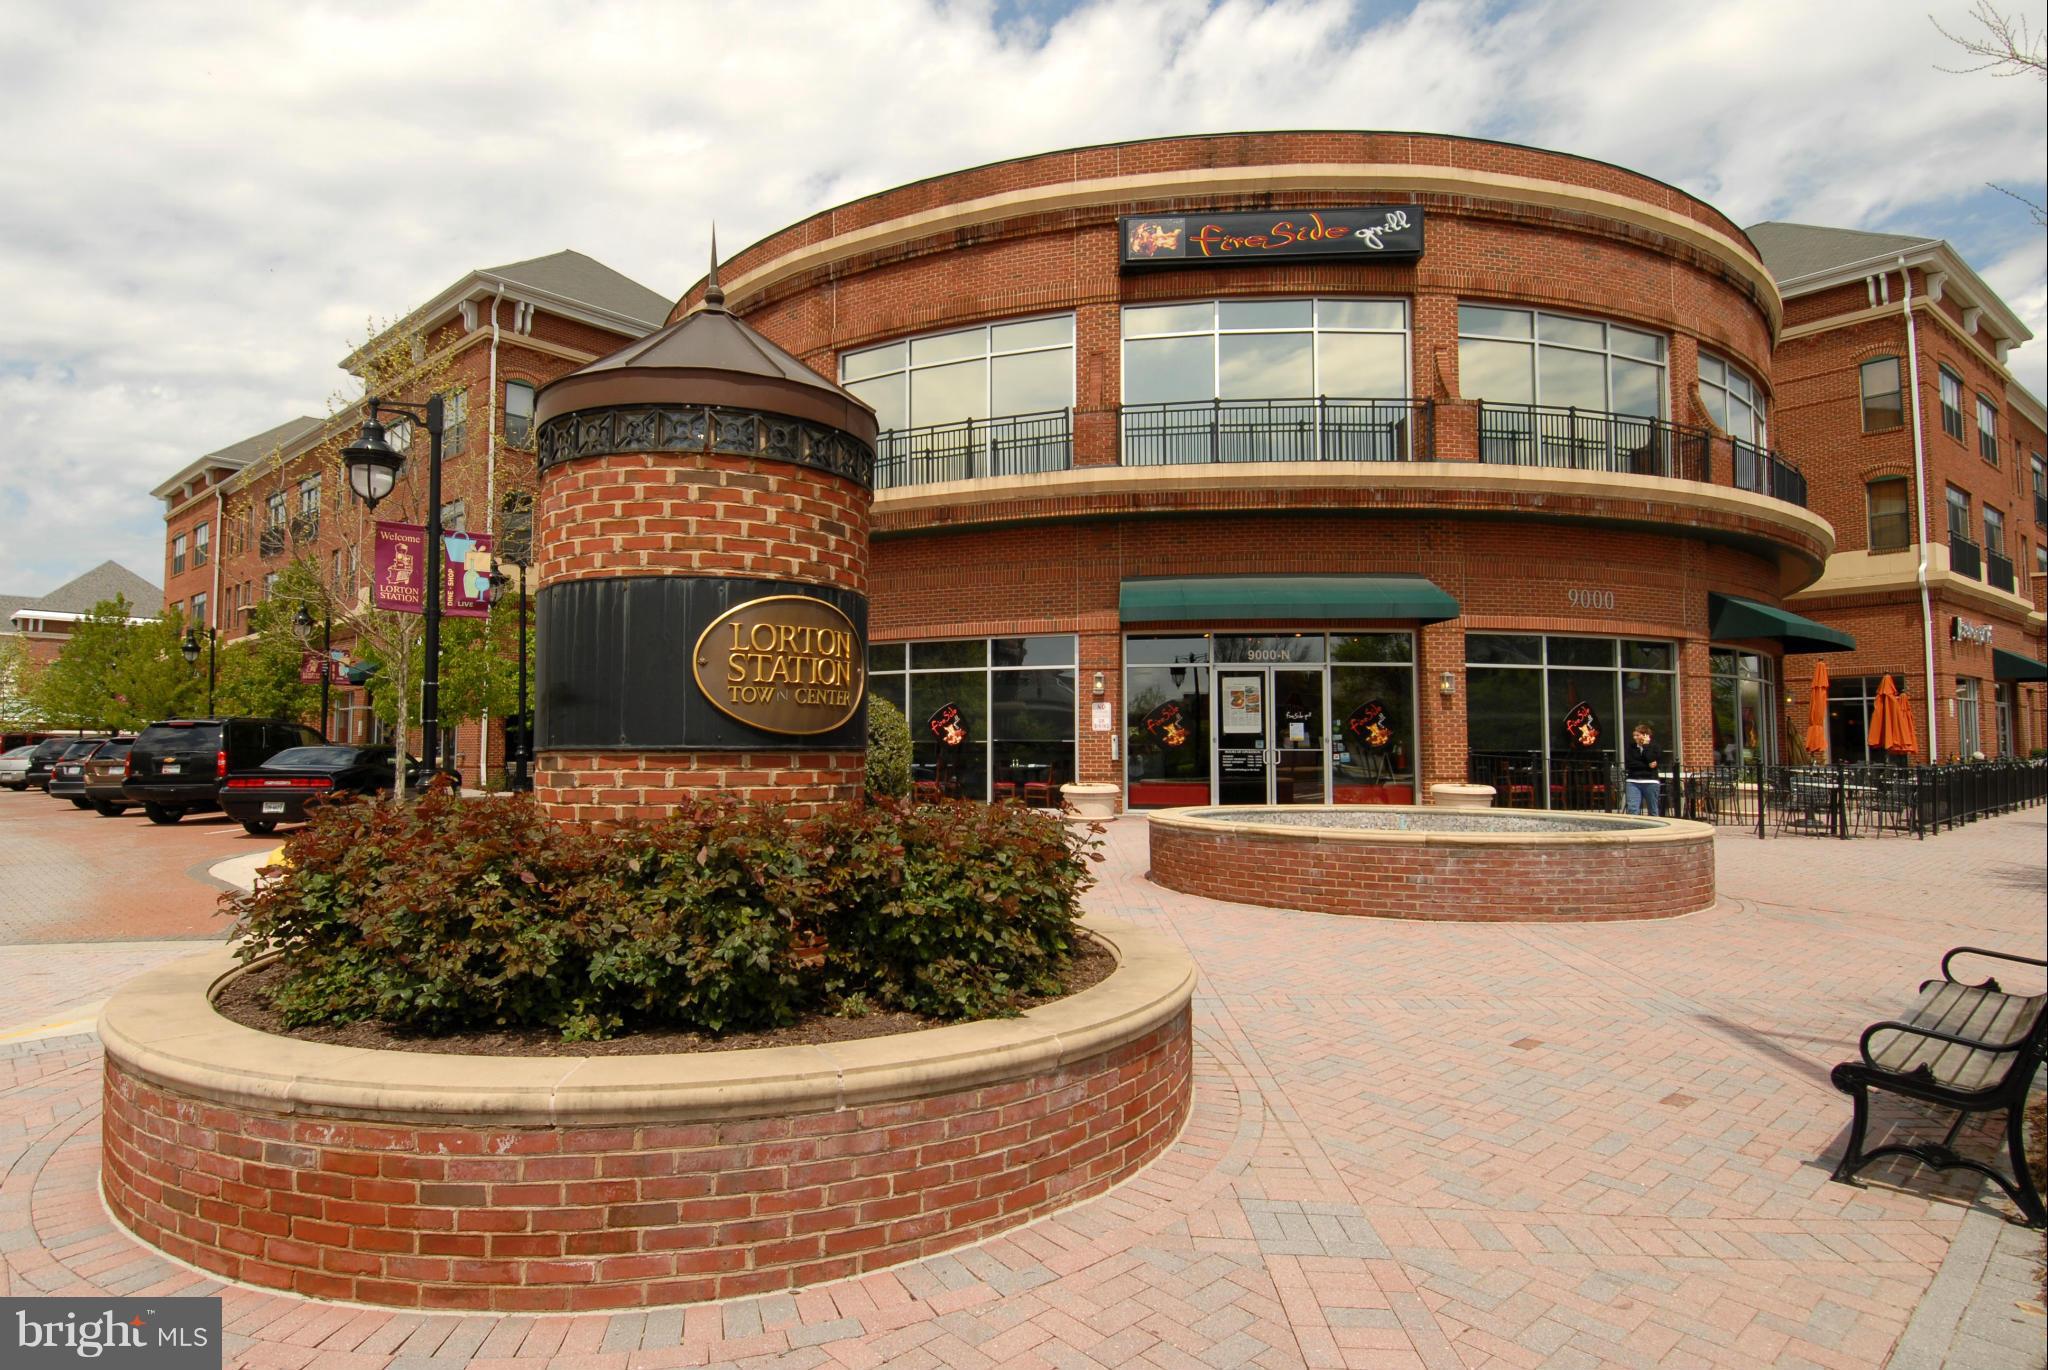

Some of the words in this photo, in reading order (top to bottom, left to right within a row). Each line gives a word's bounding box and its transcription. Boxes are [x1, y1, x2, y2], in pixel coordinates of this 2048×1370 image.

[1354, 210, 1411, 250] grill
[380, 531, 421, 543] Welcome
[447, 568, 455, 586] SHOP
[380, 584, 419, 595] LORTON
[380, 591, 419, 604] STATION
[1568, 588, 1614, 609] 9000
[457, 600, 474, 608] LIVE
[728, 622, 852, 659] LORTON
[1247, 649, 1291, 661] 9000-N
[727, 652, 852, 687] STATION
[727, 685, 789, 703] TOWN
[795, 688, 851, 706] CENTER
